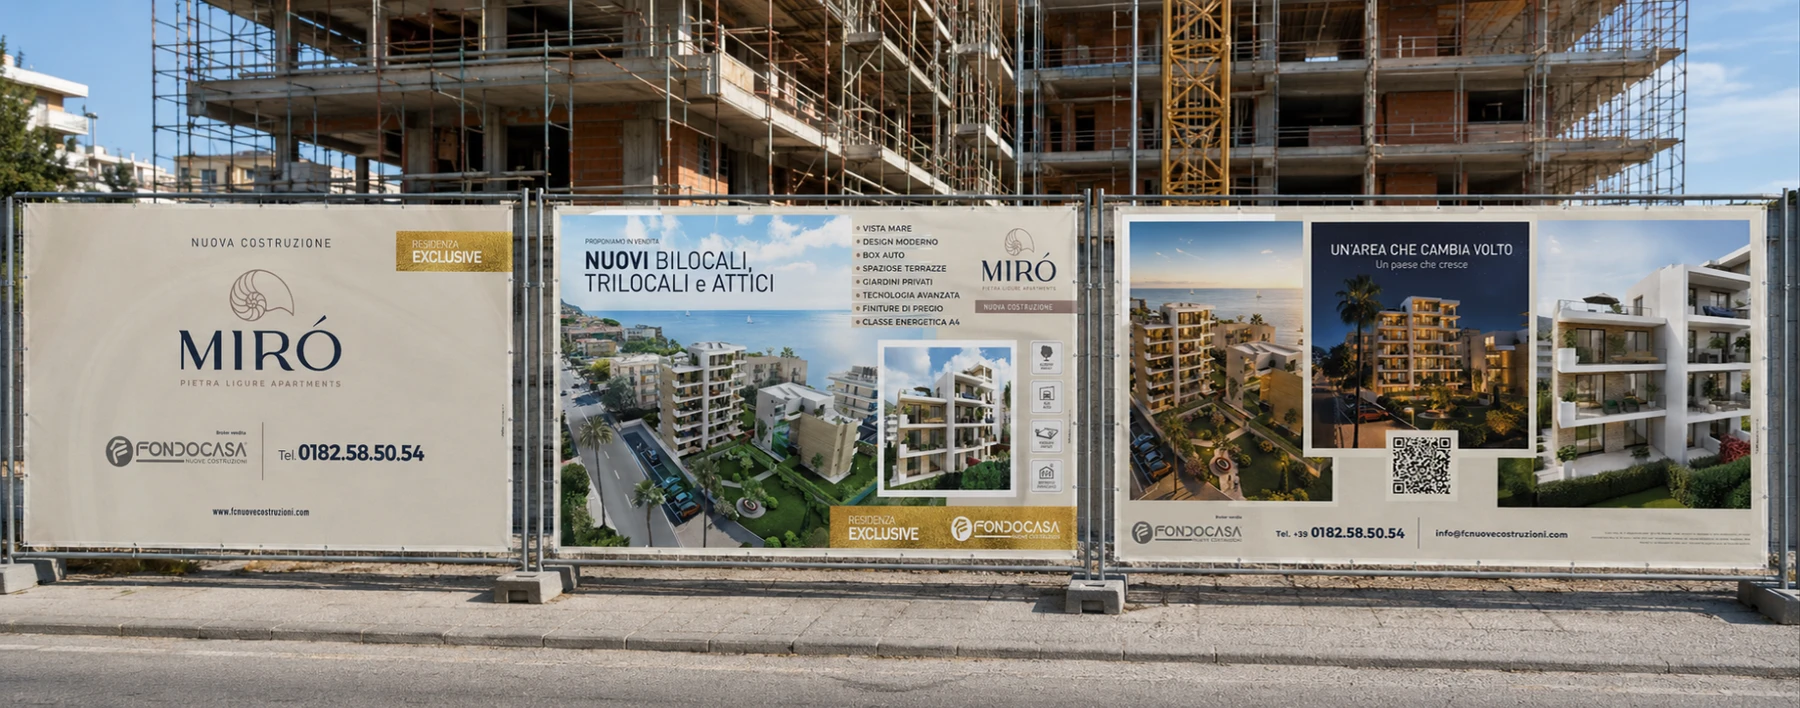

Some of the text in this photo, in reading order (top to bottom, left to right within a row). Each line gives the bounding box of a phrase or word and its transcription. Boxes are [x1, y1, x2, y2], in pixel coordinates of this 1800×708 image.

[191, 237, 332, 248] NUOVA COSTRUZIONE
[412, 240, 459, 249] RESIDENZA
[863, 238, 938, 246] DESIGN MODERNO
[1330, 244, 1513, 256] UN'AREA CHE CAMBIA VOLTO
[412, 250, 482, 263] EXCLUSIVE
[585, 251, 752, 273] NUOVI BILOCALI,
[981, 252, 1057, 282] MIRÓ
[1376, 260, 1468, 271] Un paese che cresce
[585, 274, 774, 292] TRILOCALI e ATTICI
[179, 315, 342, 371] MIRÓ
[271, 380, 341, 388] APARTMENTS
[136, 441, 247, 457] FONDOCASA
[278, 444, 425, 461] Tel. 0182.58.50.54
[212, 507, 310, 516] www.fcnuovecostruzioni.com
[848, 516, 896, 525] RESIDENZA
[974, 520, 1060, 533] FONDOCASA
[849, 527, 919, 541] EXCLUSIVE
[1154, 525, 1242, 537] FONDOCASA
[1275, 530, 1291, 538] Tel.
[1311, 526, 1406, 539] 0182.58.50.54
[1435, 529, 1569, 539] info@fcnuovecostruzioni.com
